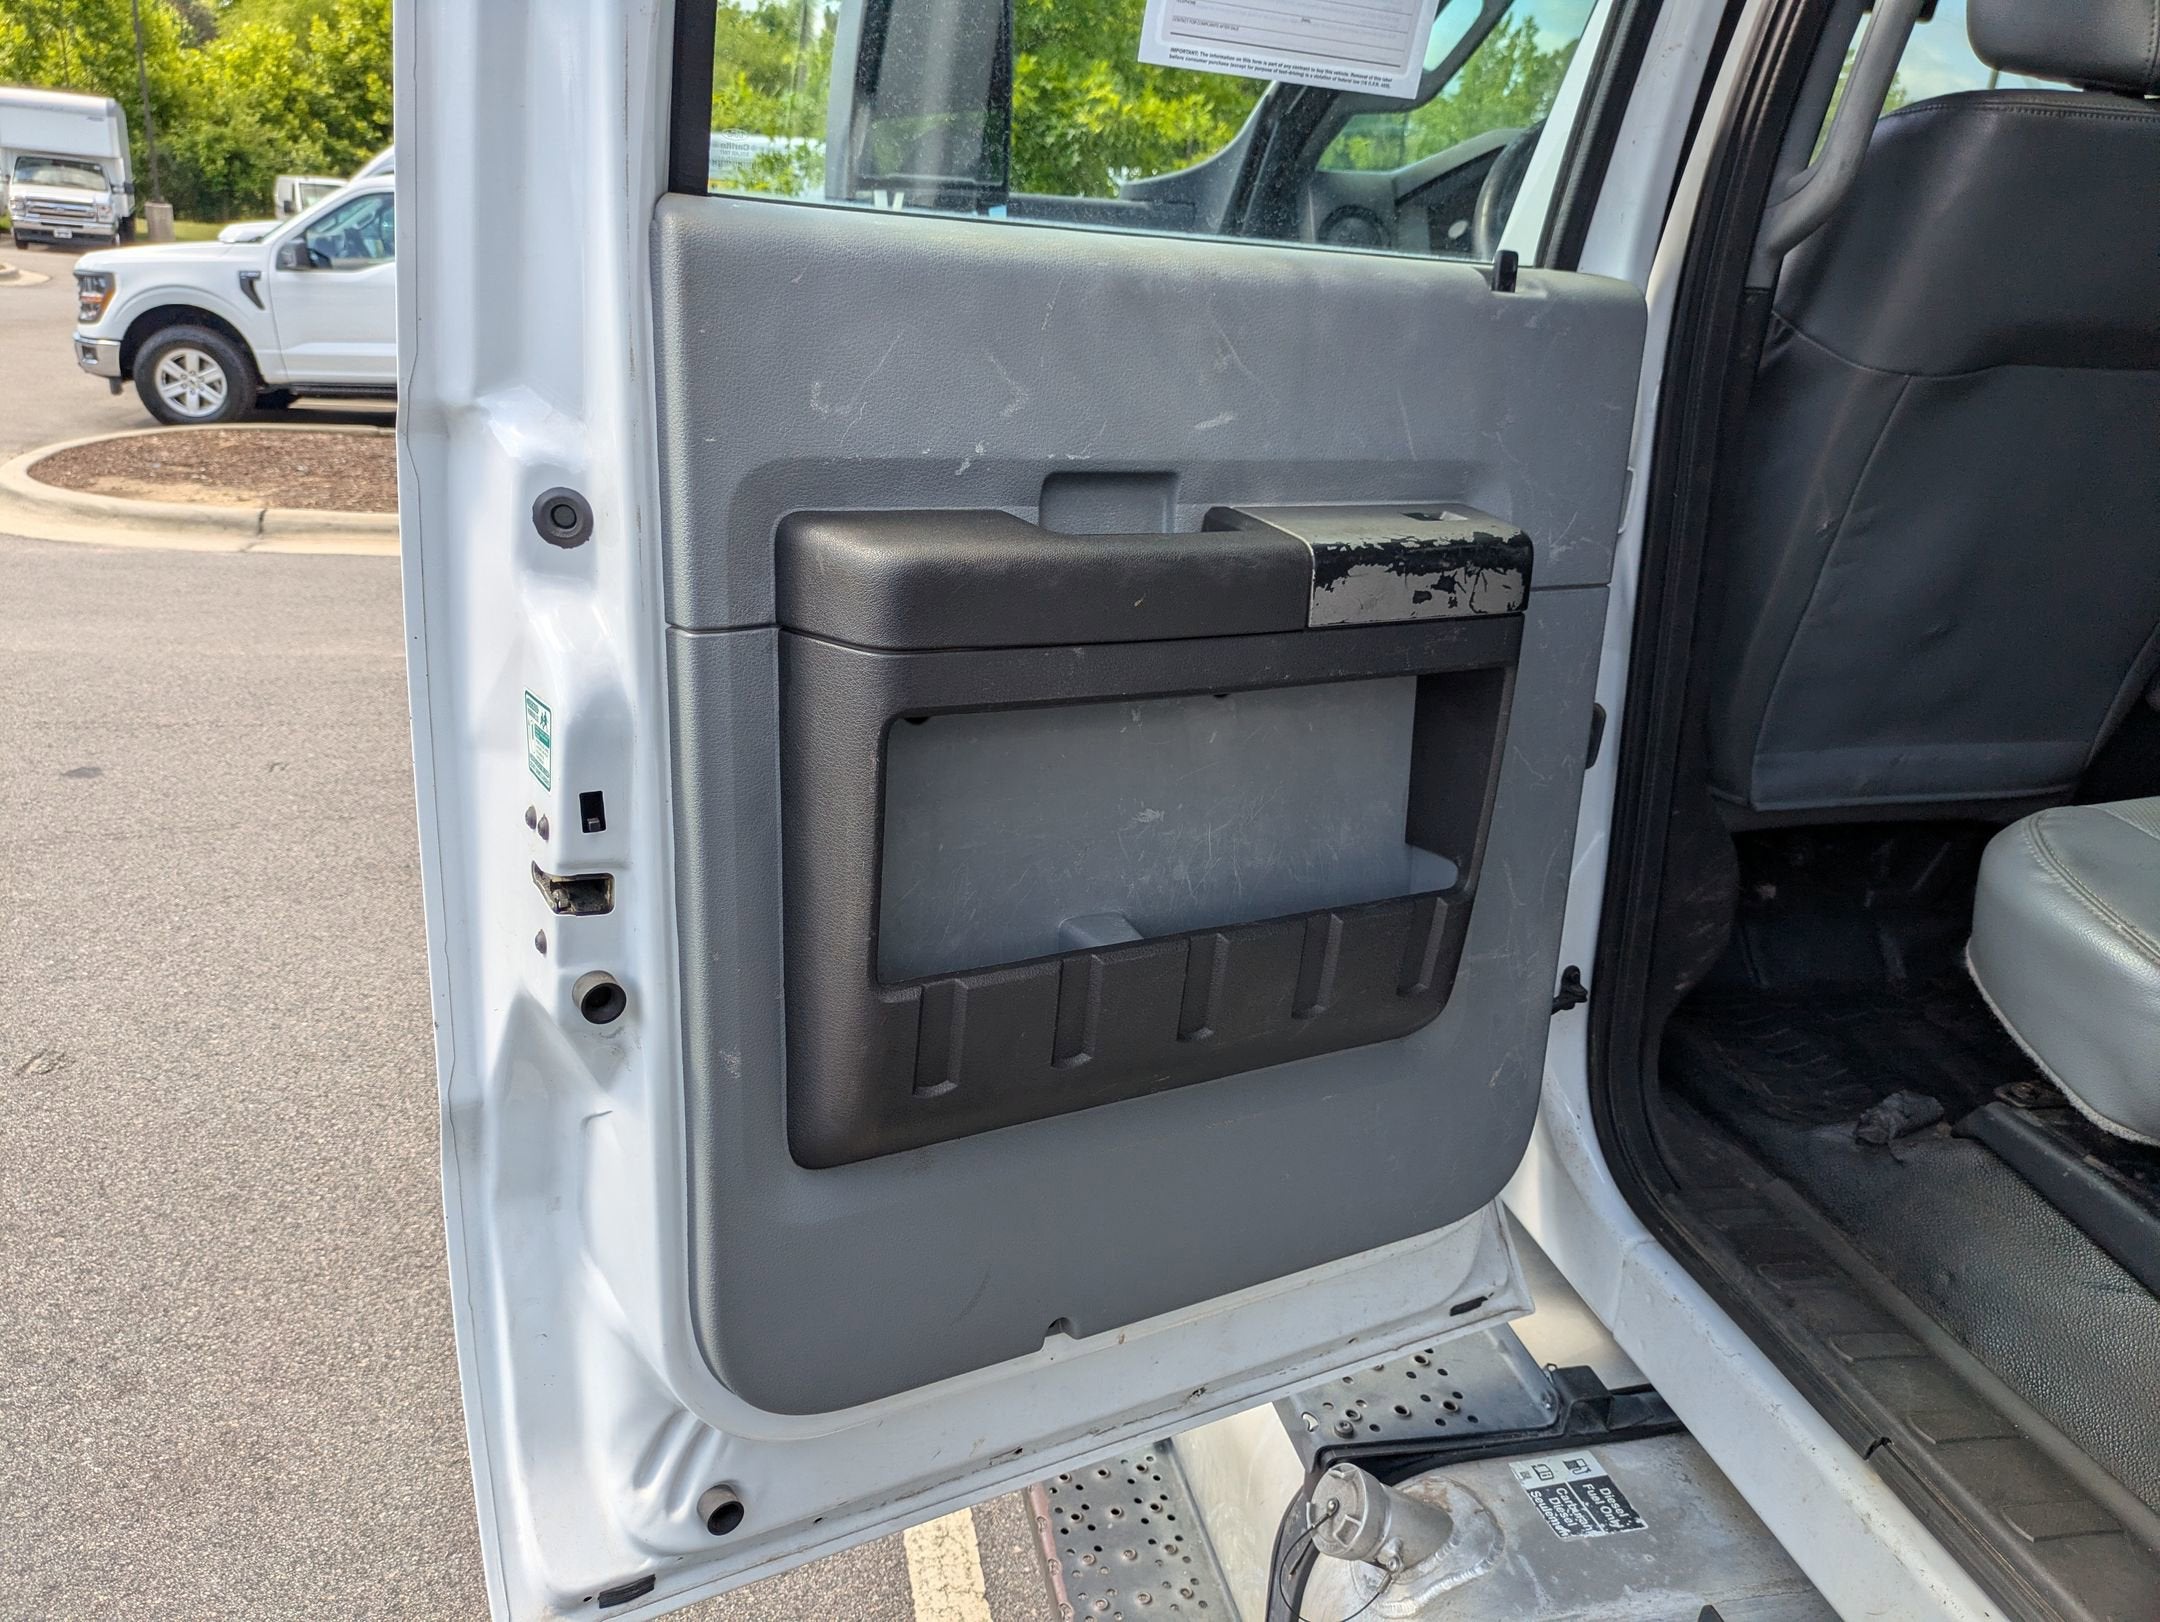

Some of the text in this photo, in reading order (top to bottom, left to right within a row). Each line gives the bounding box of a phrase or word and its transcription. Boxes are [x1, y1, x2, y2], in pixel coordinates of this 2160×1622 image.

[1170, 47, 1199, 56] IMPORTANT:
[1209, 52, 1235, 61] information
[1582, 1483, 1622, 1528] Fuel Only
[1599, 1487, 1629, 1517] Diesel
